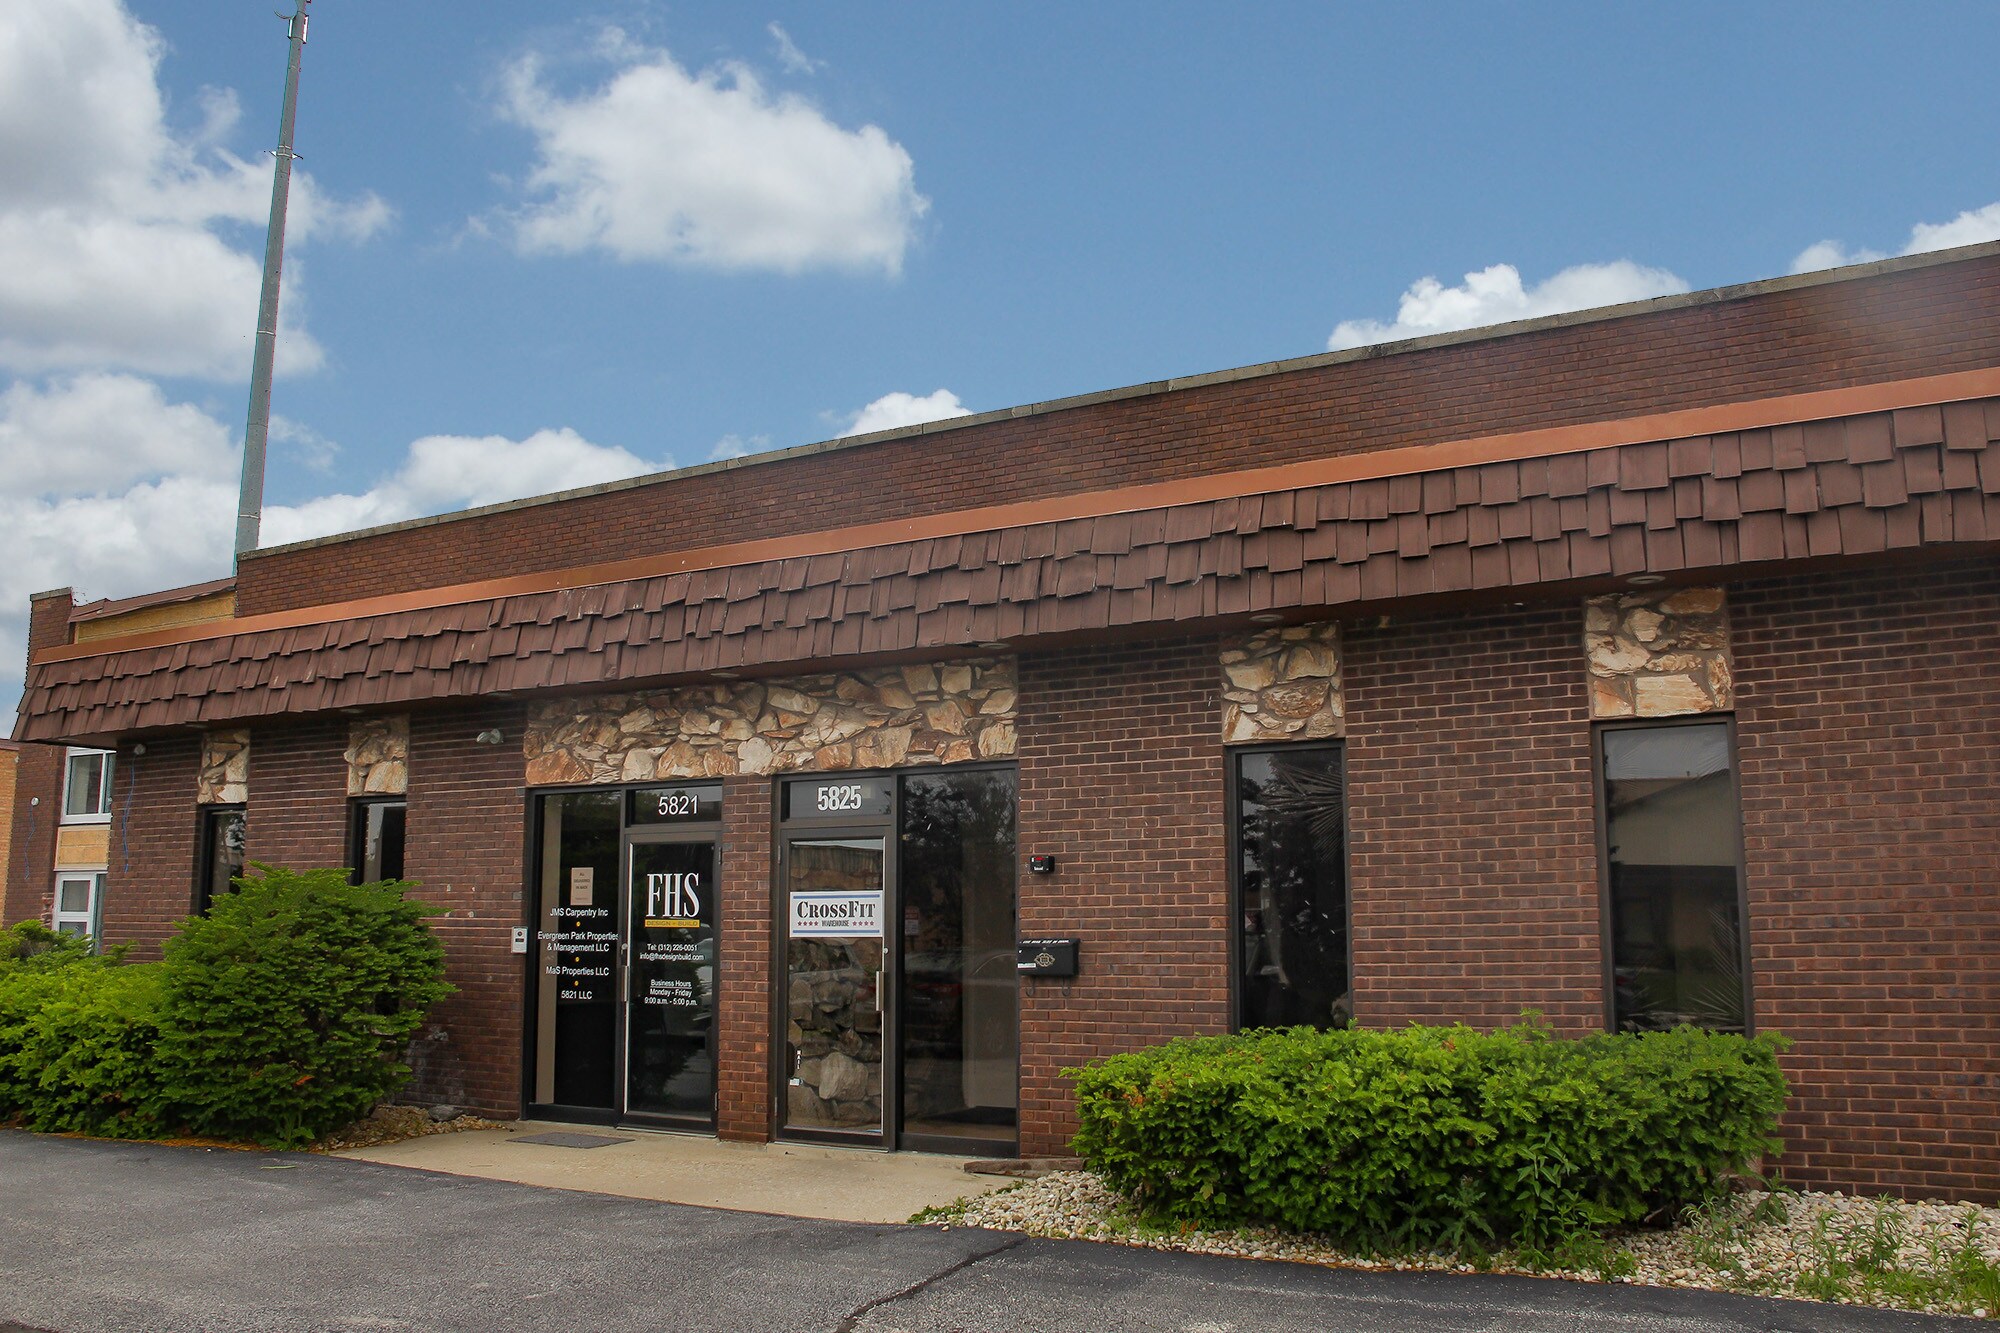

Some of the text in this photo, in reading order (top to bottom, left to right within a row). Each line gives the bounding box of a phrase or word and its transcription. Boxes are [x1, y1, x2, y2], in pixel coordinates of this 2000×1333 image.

[817, 785, 862, 811] 5825
[658, 795, 699, 816] 5821
[645, 872, 700, 918] FHS
[550, 908, 608, 918] JMS Carpentry Inc
[538, 930, 619, 942] Evergreen Park Properties
[546, 942, 610, 953] & Management LLC
[658, 943, 672, 952] (312)
[546, 966, 610, 976] MaS Properties LLC
[650, 979, 674, 987] Business
[561, 990, 592, 1000] 5821 LLC
[650, 988, 671, 997] Monday
[675, 989, 692, 998] Friday
